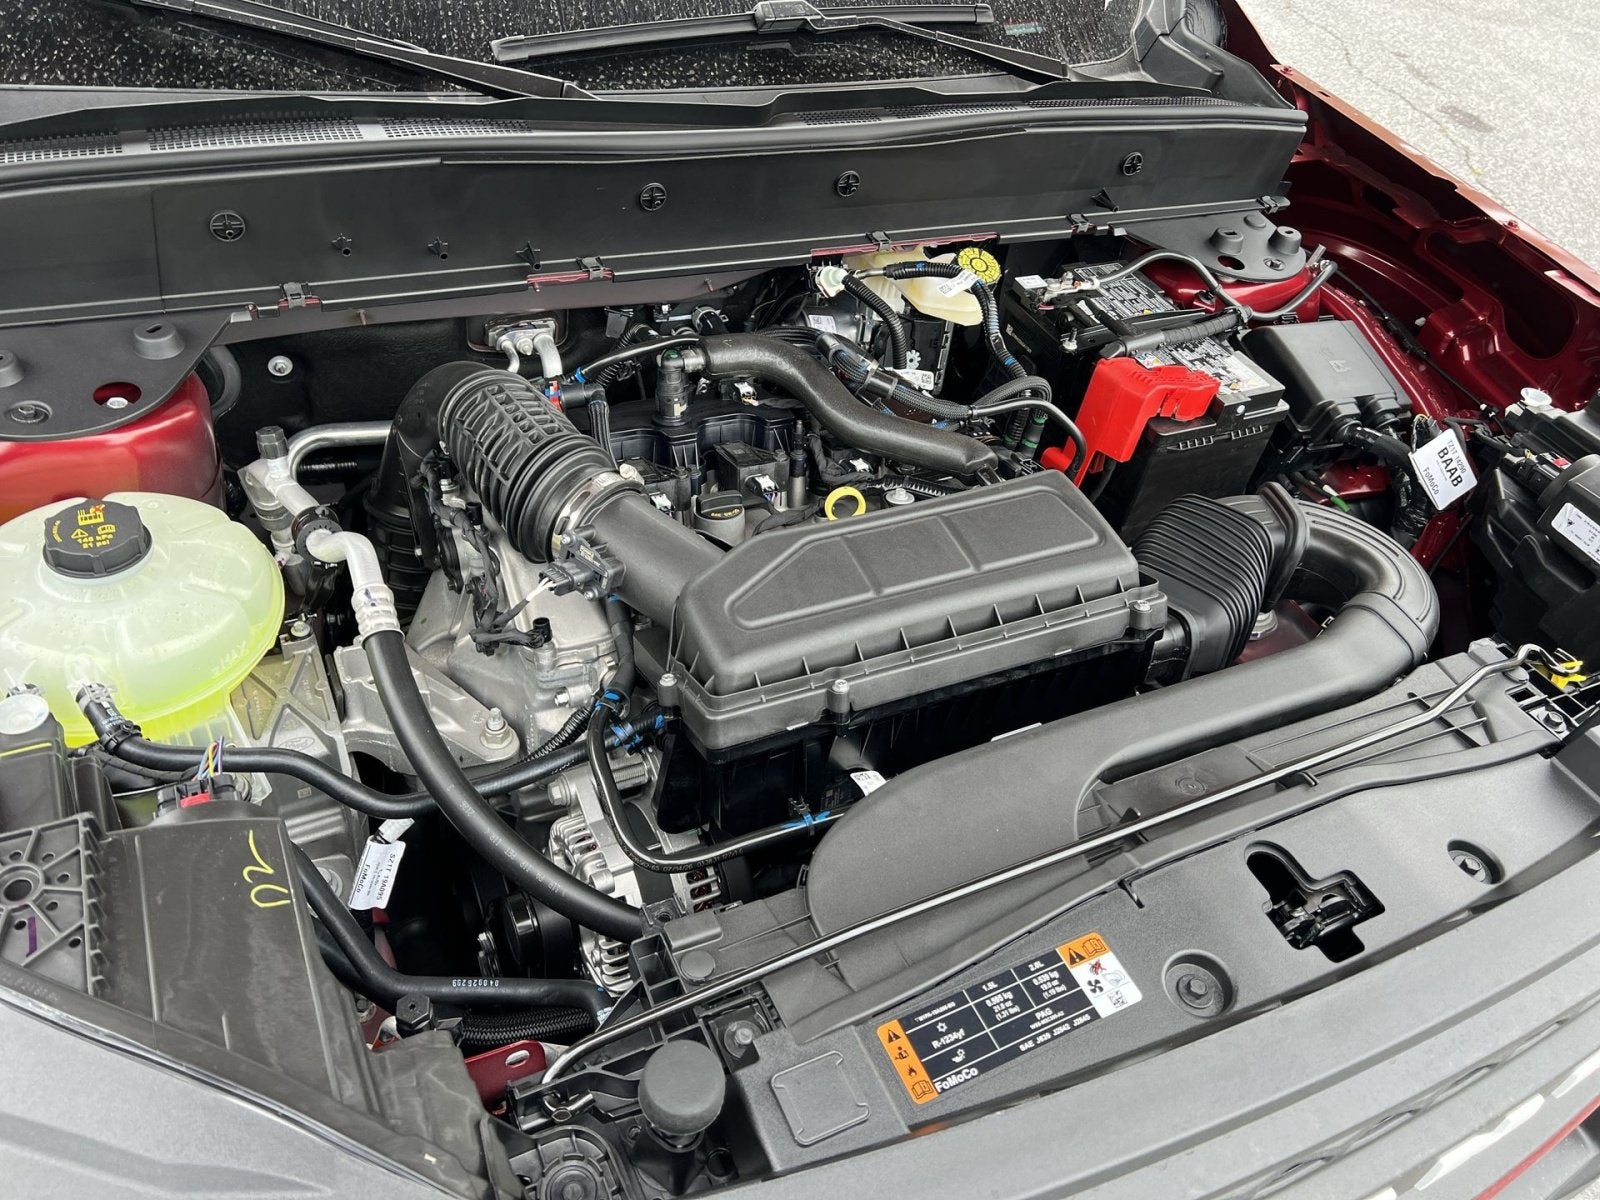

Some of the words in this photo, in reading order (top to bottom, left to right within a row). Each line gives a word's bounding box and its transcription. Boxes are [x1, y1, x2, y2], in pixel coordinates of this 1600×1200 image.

[1436, 446, 1464, 487] BAAB
[1422, 466, 1440, 495] FoMoCo
[384, 852, 396, 872] SZ1T
[355, 863, 371, 893] FoMoCo
[375, 873, 389, 901] 19A095
[1047, 968, 1060, 980] kg
[1001, 989, 1014, 1002] kg
[1034, 1006, 1053, 1020] PAG
[930, 1026, 966, 1051] R-1234yf
[1018, 1039, 1035, 1052] SAE
[933, 1063, 979, 1093] FoMoCo
